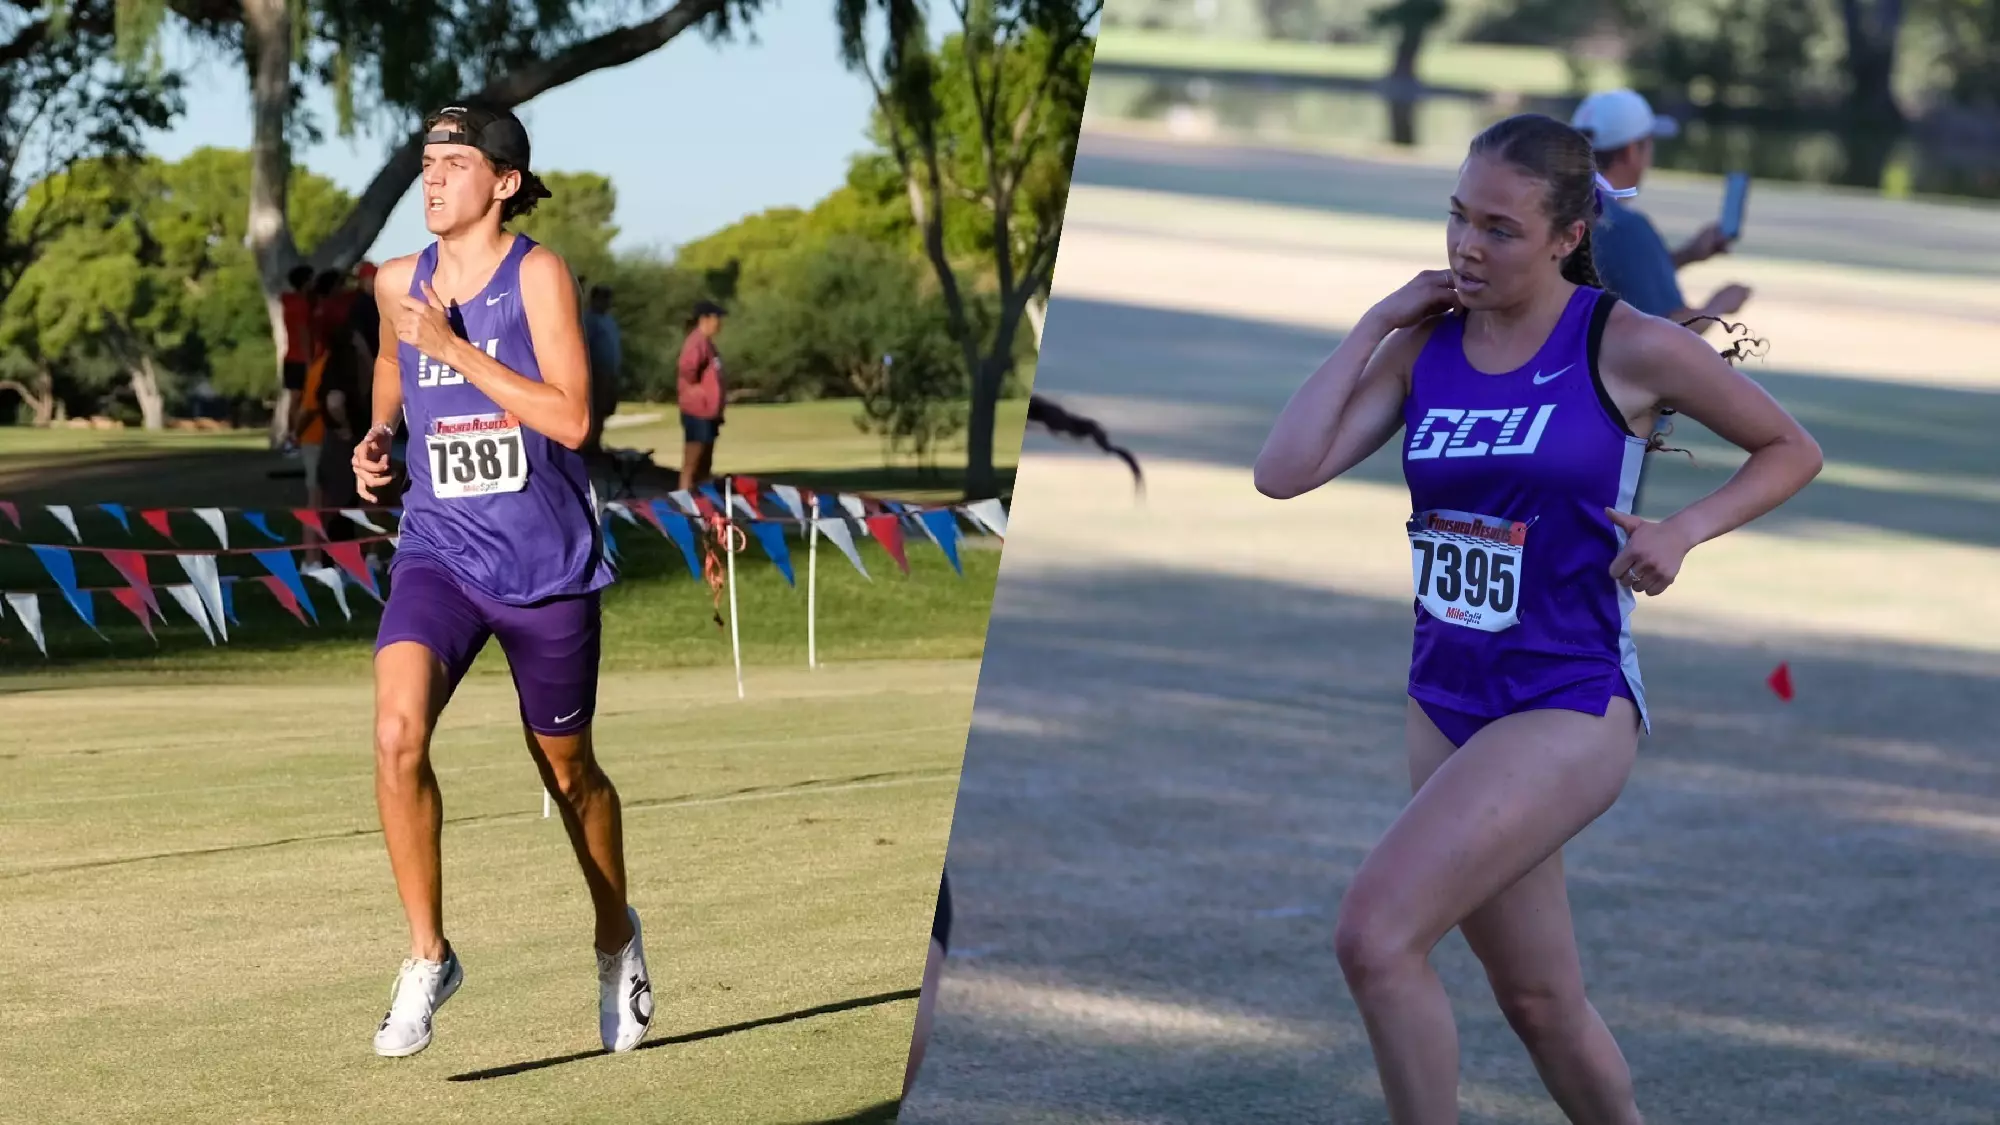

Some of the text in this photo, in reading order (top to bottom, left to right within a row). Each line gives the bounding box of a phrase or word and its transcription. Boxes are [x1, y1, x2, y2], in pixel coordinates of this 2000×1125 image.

[429, 435, 519, 485] 7387
[1407, 403, 1558, 461] GCU
[1412, 539, 1515, 614] 7395
